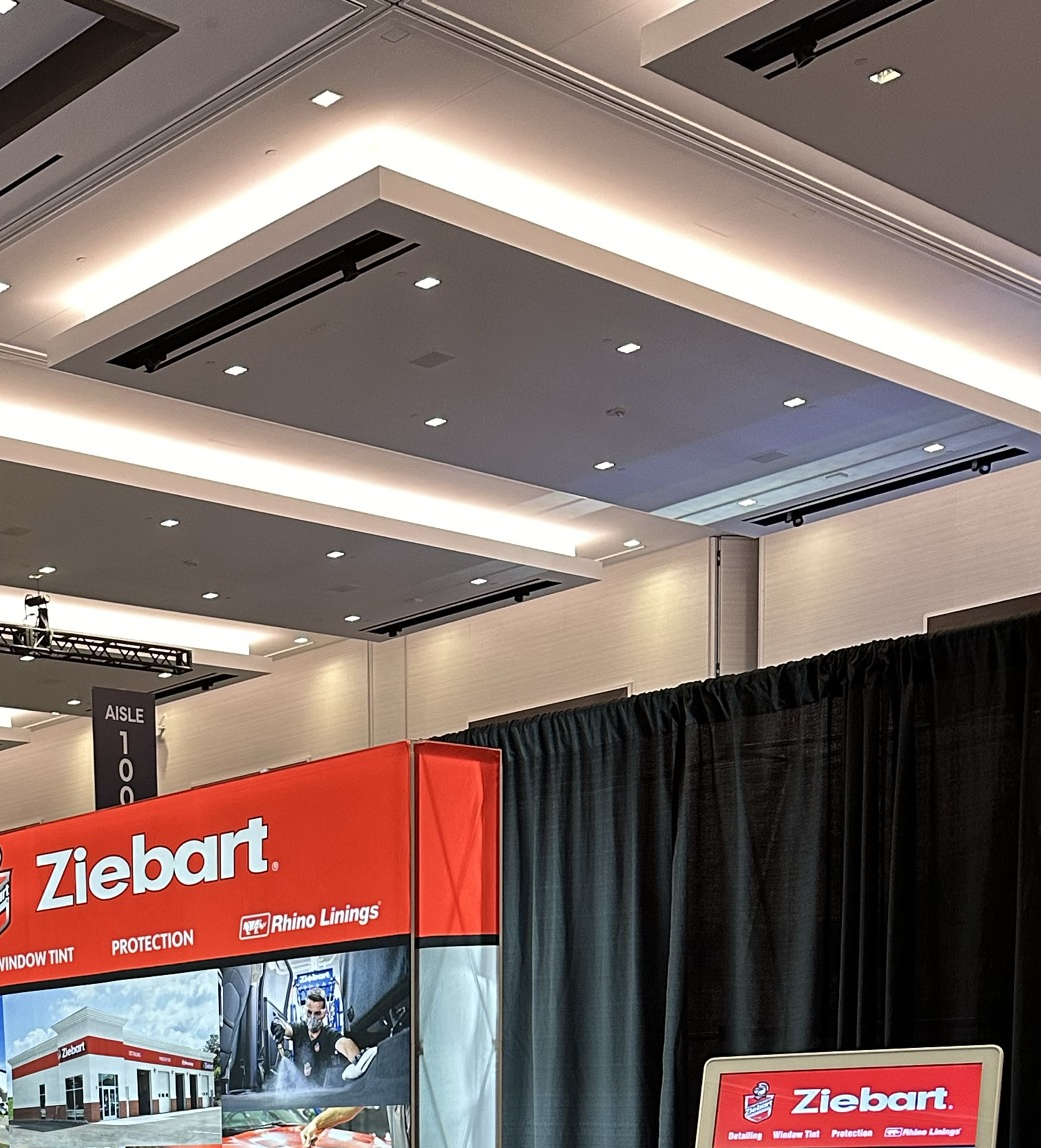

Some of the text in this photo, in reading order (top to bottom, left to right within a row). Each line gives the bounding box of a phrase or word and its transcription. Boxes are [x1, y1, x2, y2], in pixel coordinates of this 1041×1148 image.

[105, 704, 144, 723] AISLE
[35, 816, 268, 912] Ziebart
[271, 903, 380, 934] Rhino Linings
[111, 929, 194, 956] PROTECTION
[49, 946, 75, 965] TINT
[61, 1041, 86, 1059] Ziebart
[728, 1127, 961, 1141] Detailing Window Tint Protection Rhino Linings
